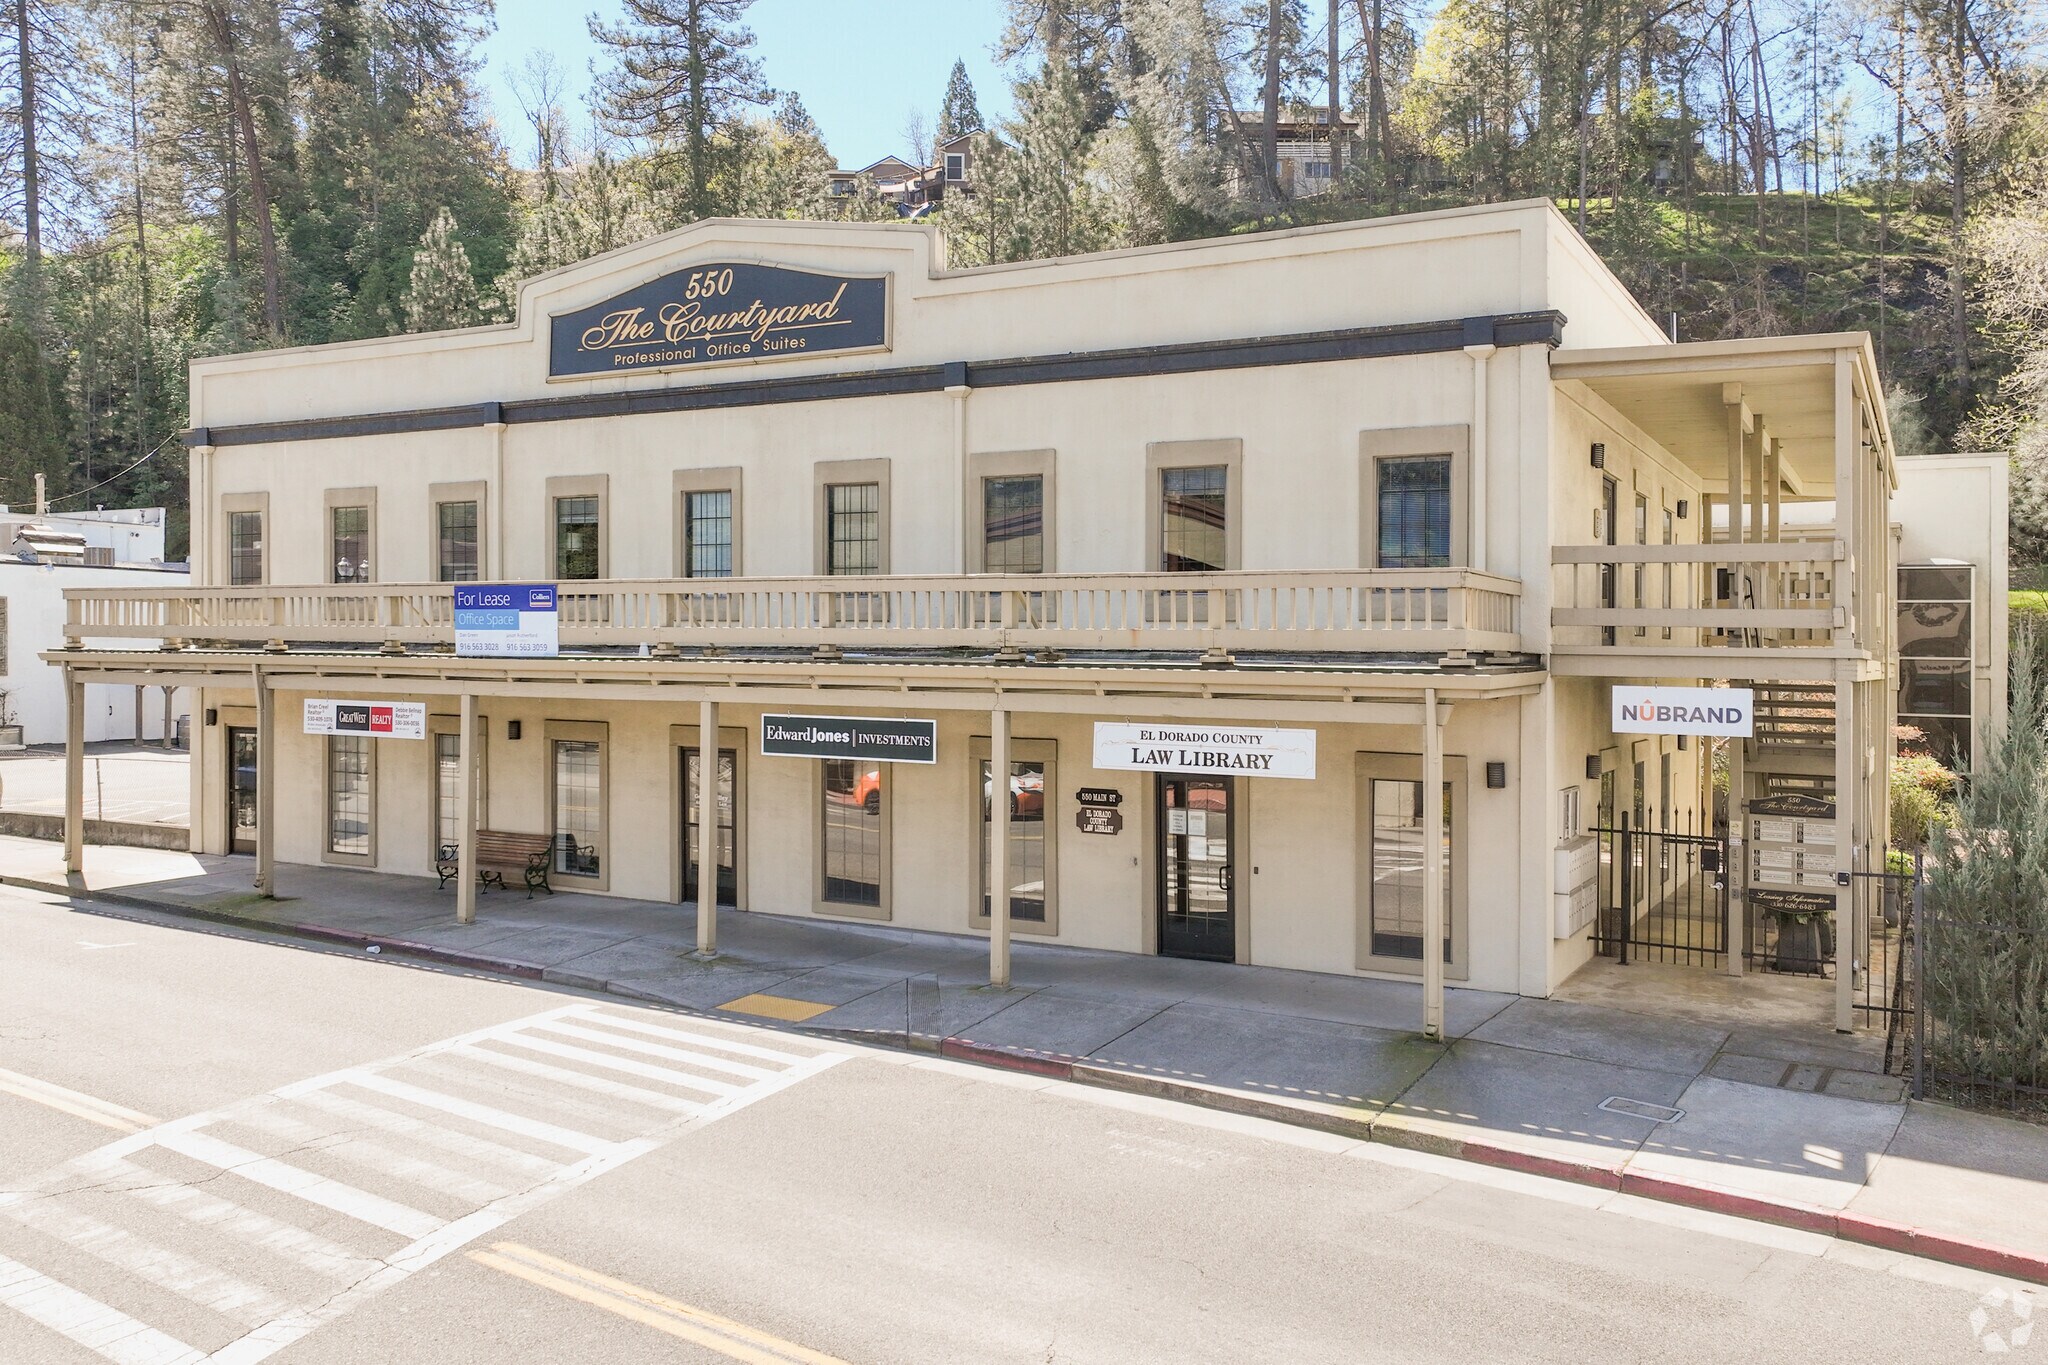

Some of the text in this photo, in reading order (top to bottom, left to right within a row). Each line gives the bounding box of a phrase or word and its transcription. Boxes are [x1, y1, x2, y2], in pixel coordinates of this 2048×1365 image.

[686, 268, 733, 300] 550
[581, 283, 848, 351] The Courtyard
[614, 336, 806, 366] Professional Office Suites
[458, 592, 510, 606] For Lease
[458, 613, 514, 628] Office Space
[506, 643, 518, 651] 916
[532, 644, 548, 652] 3059
[371, 715, 392, 725] REALTY
[858, 733, 931, 747] INVESTMENTS
[1140, 730, 1263, 745] EL DORADO COUNTY
[1131, 747, 1274, 770] LAW LIBRARY
[1081, 793, 1092, 801] 550
[1092, 793, 1107, 802] MAIN
[1085, 809, 1112, 819] EL DORADO
[1780, 803, 1830, 813] Courtyard
[1090, 817, 1108, 825] COUNTY
[1083, 823, 1114, 833] LAW LIBRARY
[1756, 891, 1830, 904] Leasing Information
